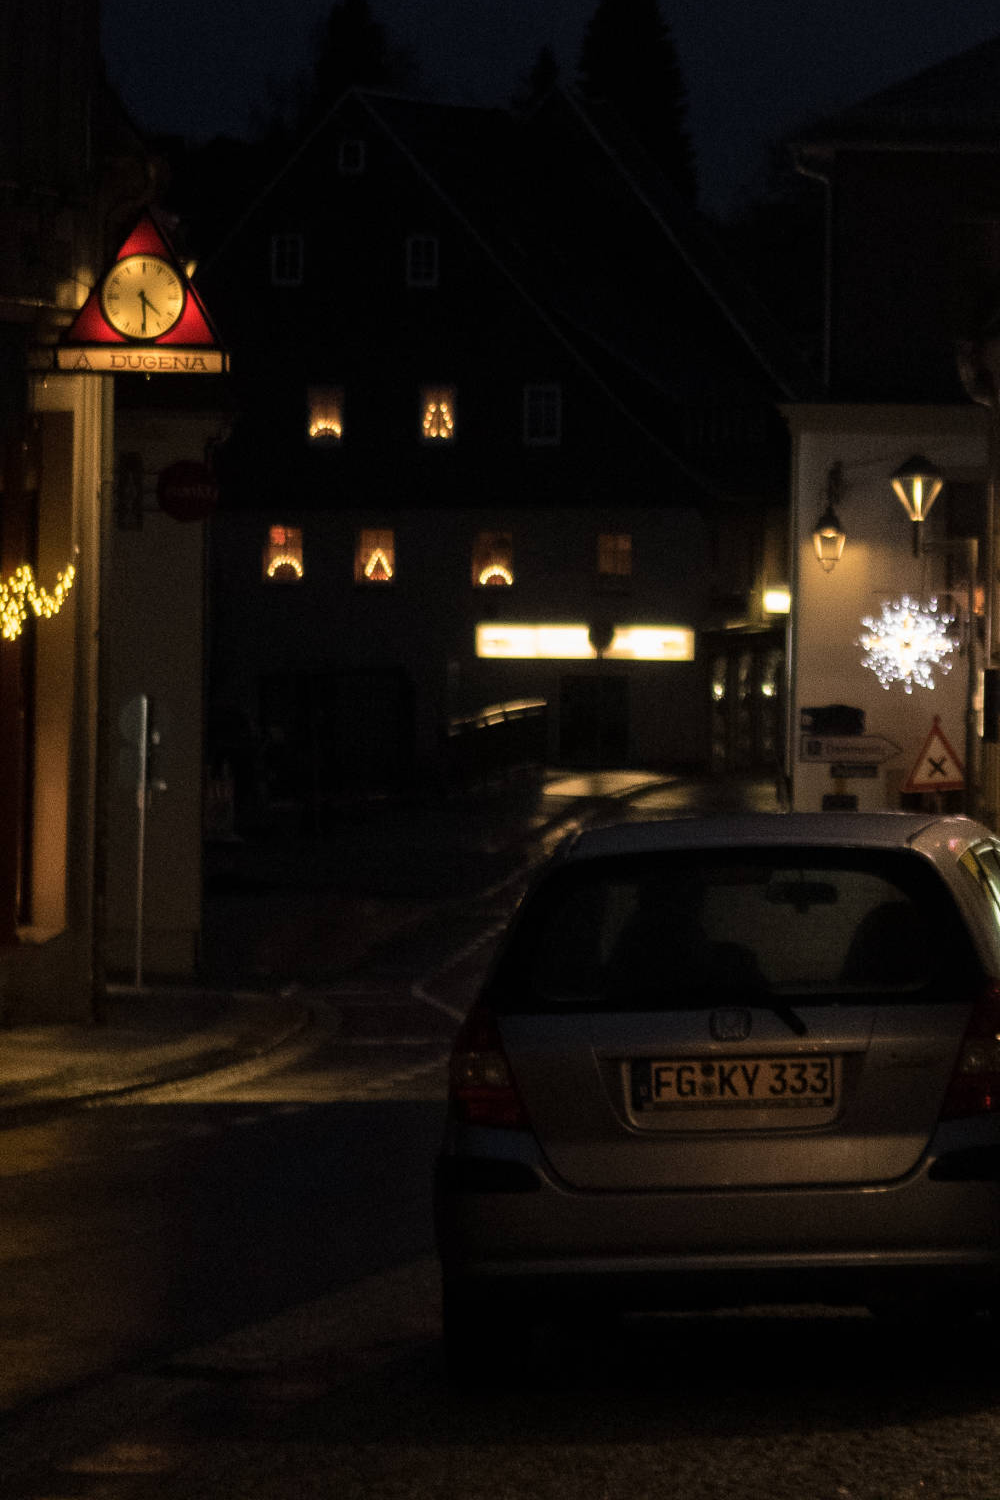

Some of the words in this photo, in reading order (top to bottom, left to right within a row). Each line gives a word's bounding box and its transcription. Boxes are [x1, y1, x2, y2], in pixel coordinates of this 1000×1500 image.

[110, 354, 208, 371] DUGENA
[654, 1065, 697, 1098] FG
[718, 1064, 760, 1097] KY
[769, 1062, 829, 1096] 333
